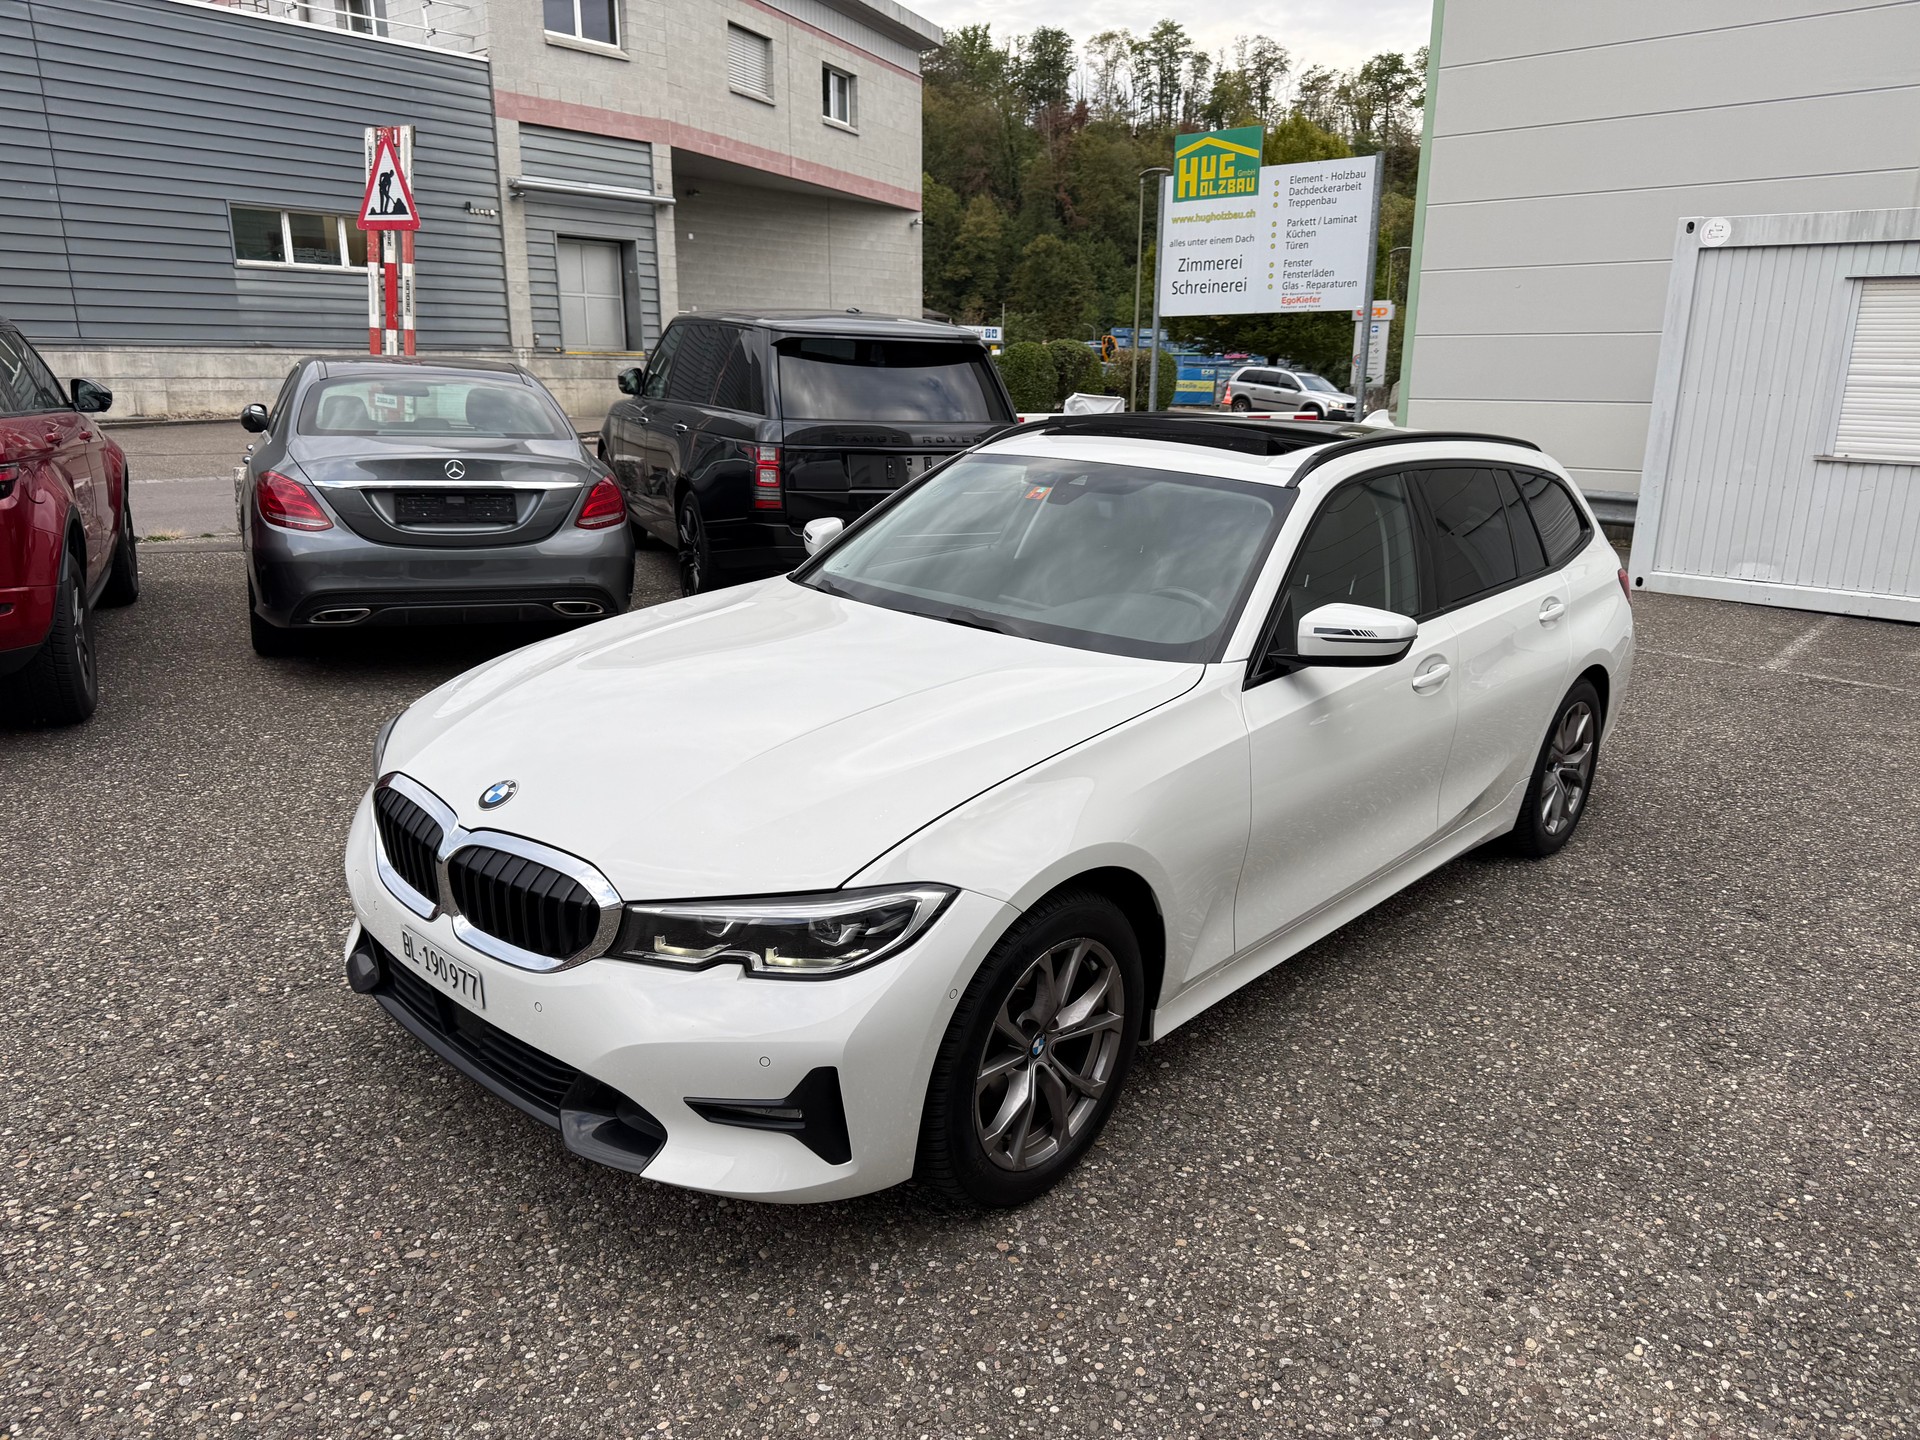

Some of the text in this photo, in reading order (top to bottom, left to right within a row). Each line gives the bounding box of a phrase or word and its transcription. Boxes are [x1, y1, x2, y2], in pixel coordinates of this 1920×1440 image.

[1178, 153, 1235, 198] HUG
[1238, 168, 1256, 176] GmbH
[1290, 174, 1323, 184] Element
[1330, 170, 1366, 180] Holzbau
[1289, 182, 1362, 196] Dachdeckerarbeit
[1288, 196, 1337, 208] Treppenbau
[1172, 208, 1256, 224] www.hugholzbau.ch
[1286, 218, 1316, 227] Parkett
[1324, 214, 1358, 224] Laminat
[1286, 229, 1316, 238] Küchen
[1169, 234, 1254, 248] alles unter einem Dach
[1286, 241, 1308, 250] Türen
[1178, 254, 1242, 272] Zimmerei
[1284, 259, 1312, 268] Fenster
[1282, 269, 1334, 279] Fensterläden
[1172, 277, 1247, 295] Schreinerei
[1282, 281, 1299, 290] Glas
[1306, 280, 1358, 290] Reparaturen
[1281, 296, 1321, 305] EgoKiefer
[1356, 307, 1388, 318] cop
[834, 436, 900, 444] RANGE
